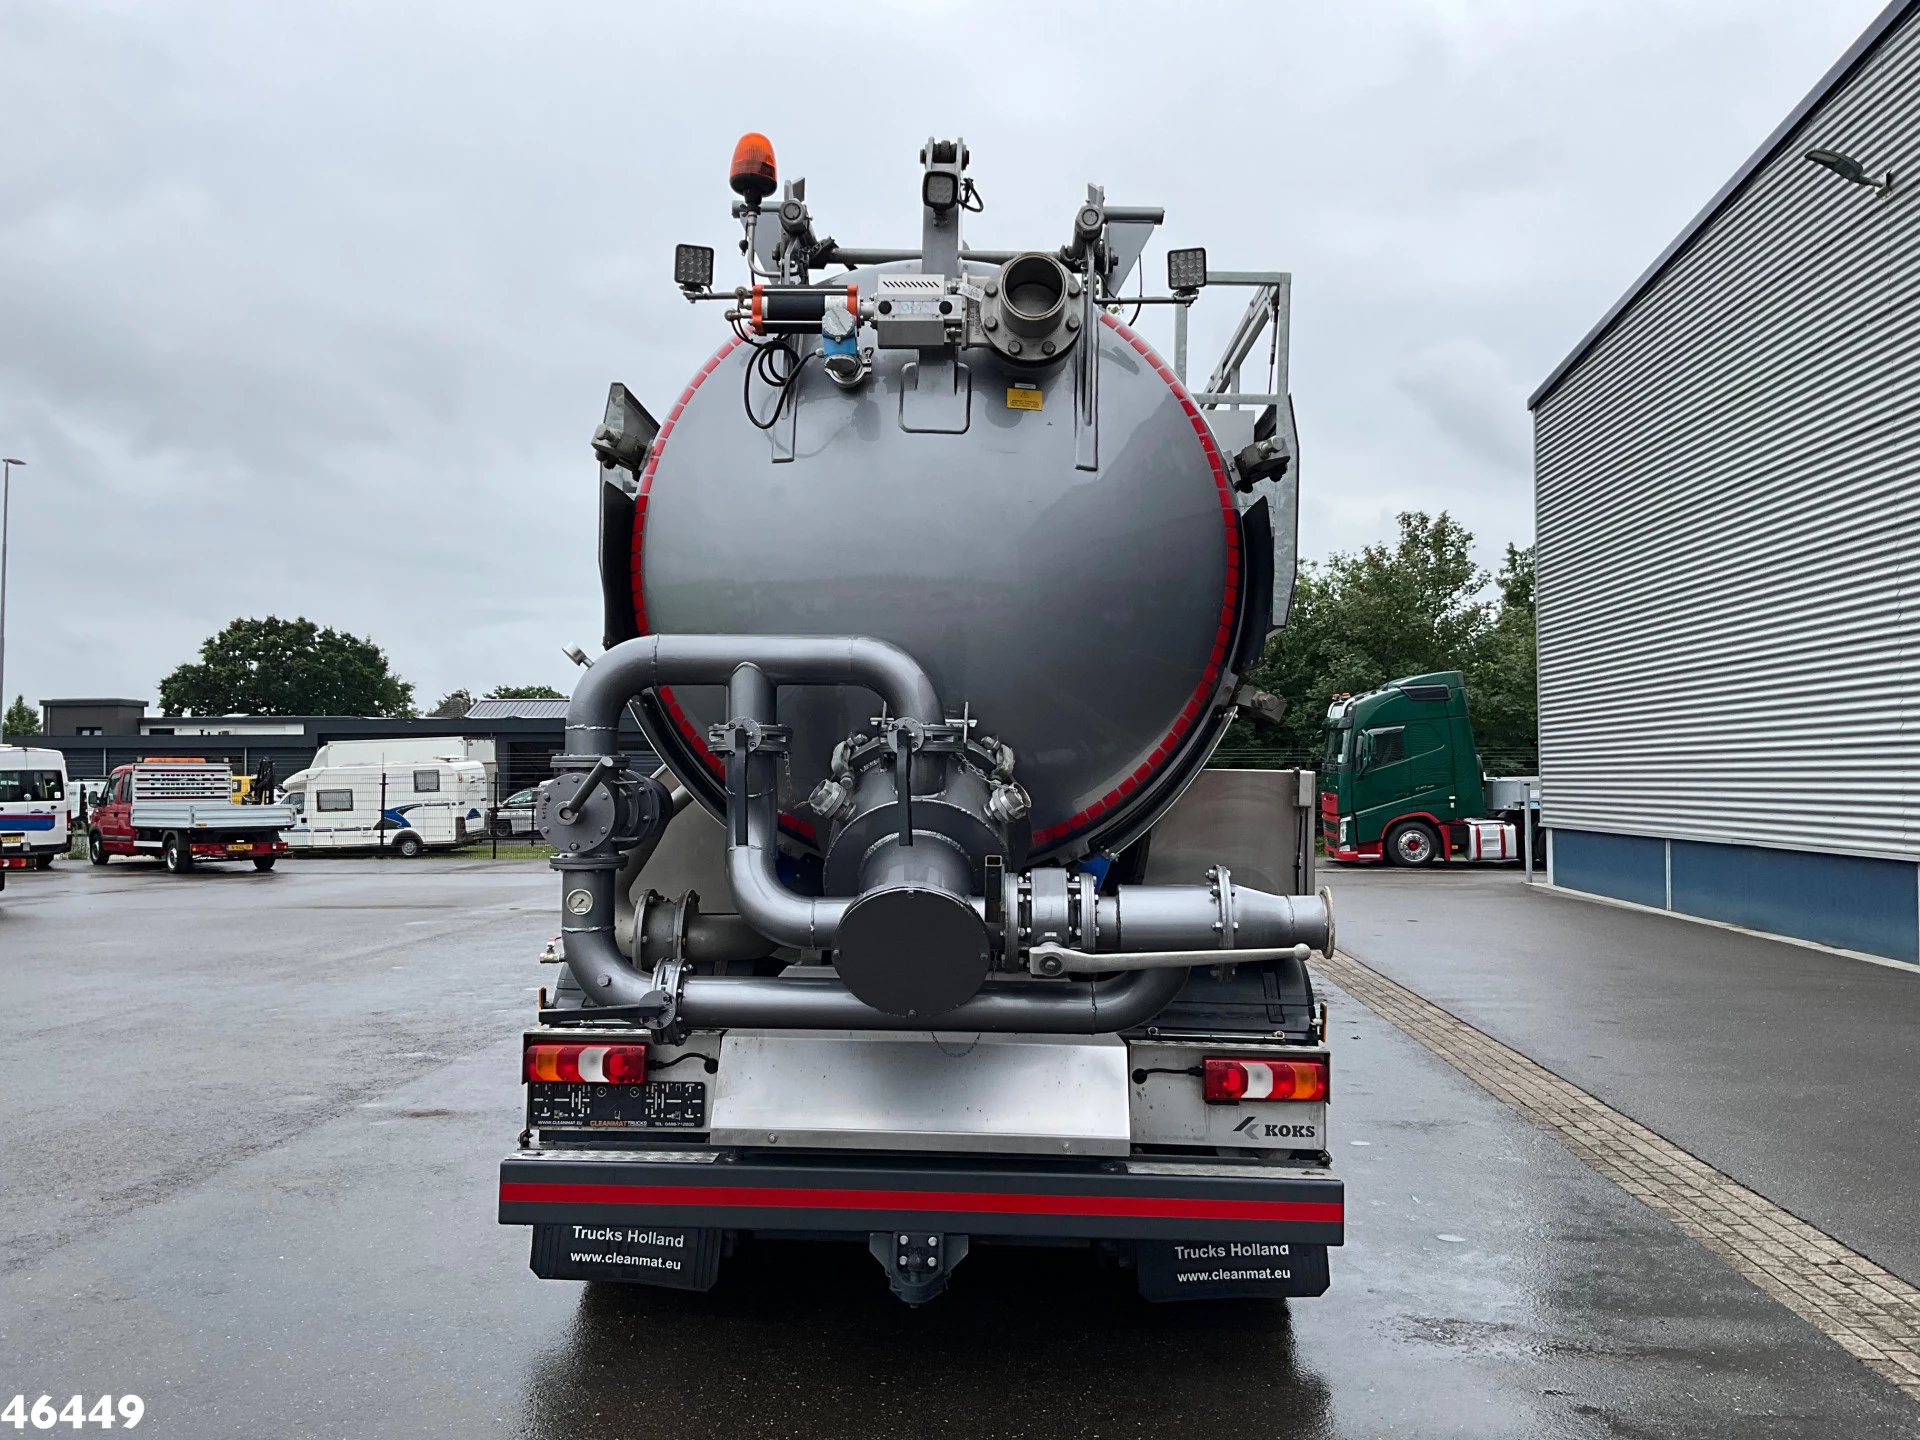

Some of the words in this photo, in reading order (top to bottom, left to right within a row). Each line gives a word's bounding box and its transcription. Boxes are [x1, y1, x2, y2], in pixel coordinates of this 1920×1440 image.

[1264, 1124, 1316, 1138] KOKS
[572, 1225, 623, 1242] Trucks
[627, 1229, 684, 1248] Holland
[1174, 1244, 1226, 1260] Trucks
[1230, 1243, 1289, 1257] Holland
[570, 1252, 681, 1270] www.cleanmat.eu
[1177, 1268, 1291, 1283] www.cleanmat.eu
